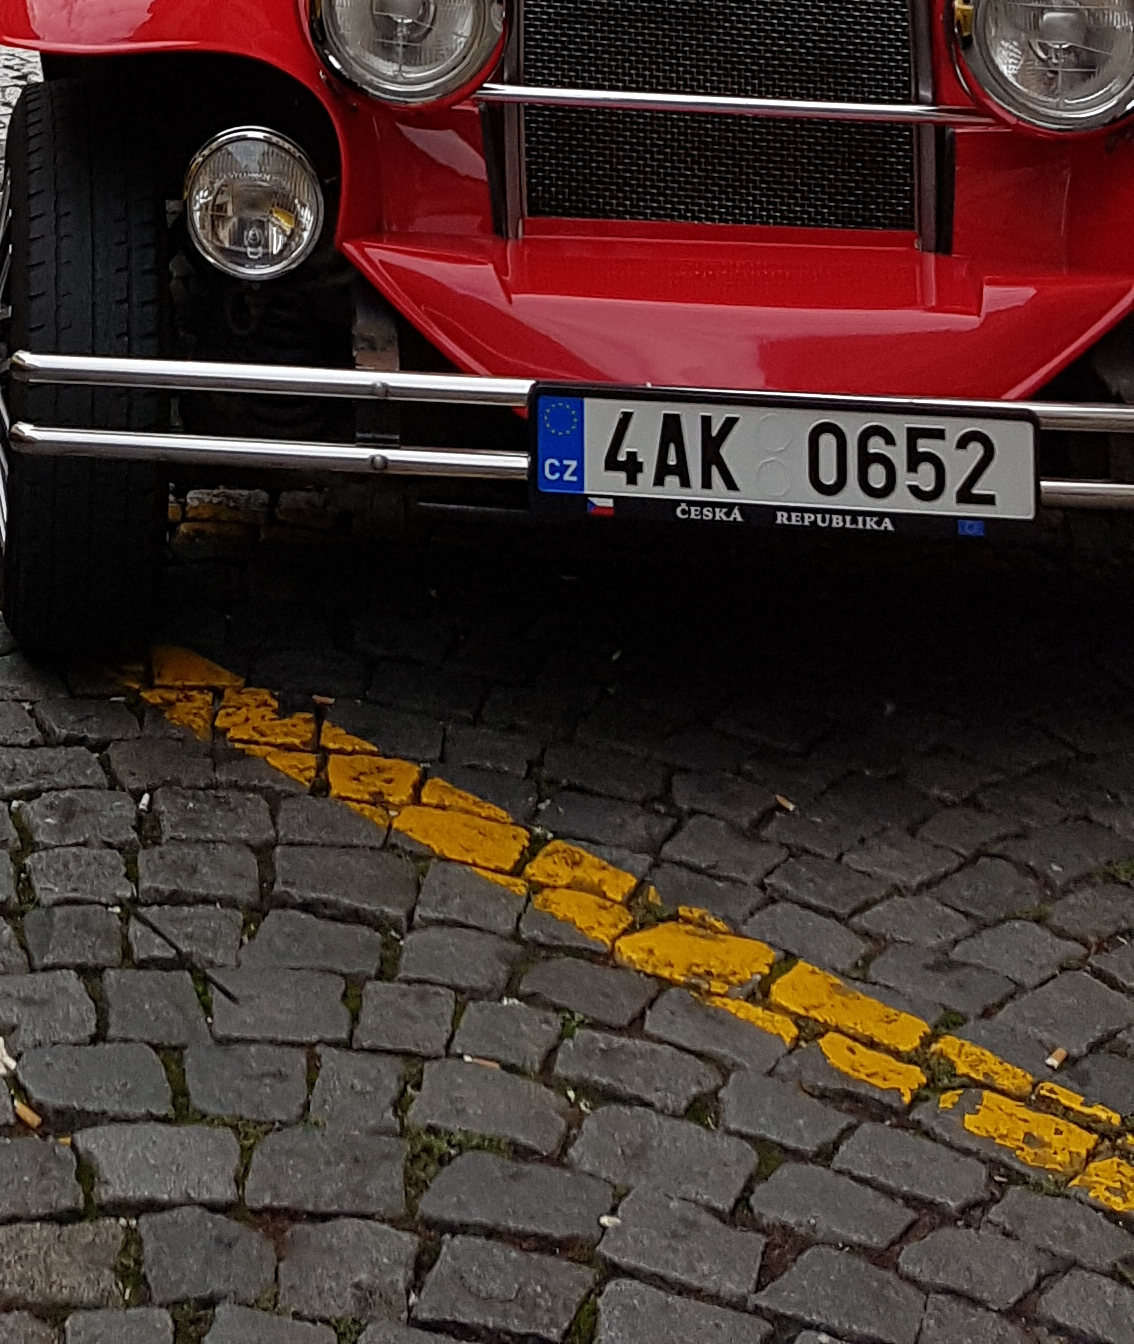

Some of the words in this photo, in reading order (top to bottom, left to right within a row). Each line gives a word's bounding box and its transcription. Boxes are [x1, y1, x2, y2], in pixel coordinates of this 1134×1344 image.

[543, 458, 579, 483] CZ
[603, 410, 741, 493] 4AK
[806, 418, 998, 507] 0652
[675, 501, 745, 523] ČESKÁ
[774, 510, 896, 533] REPUBLIKA
